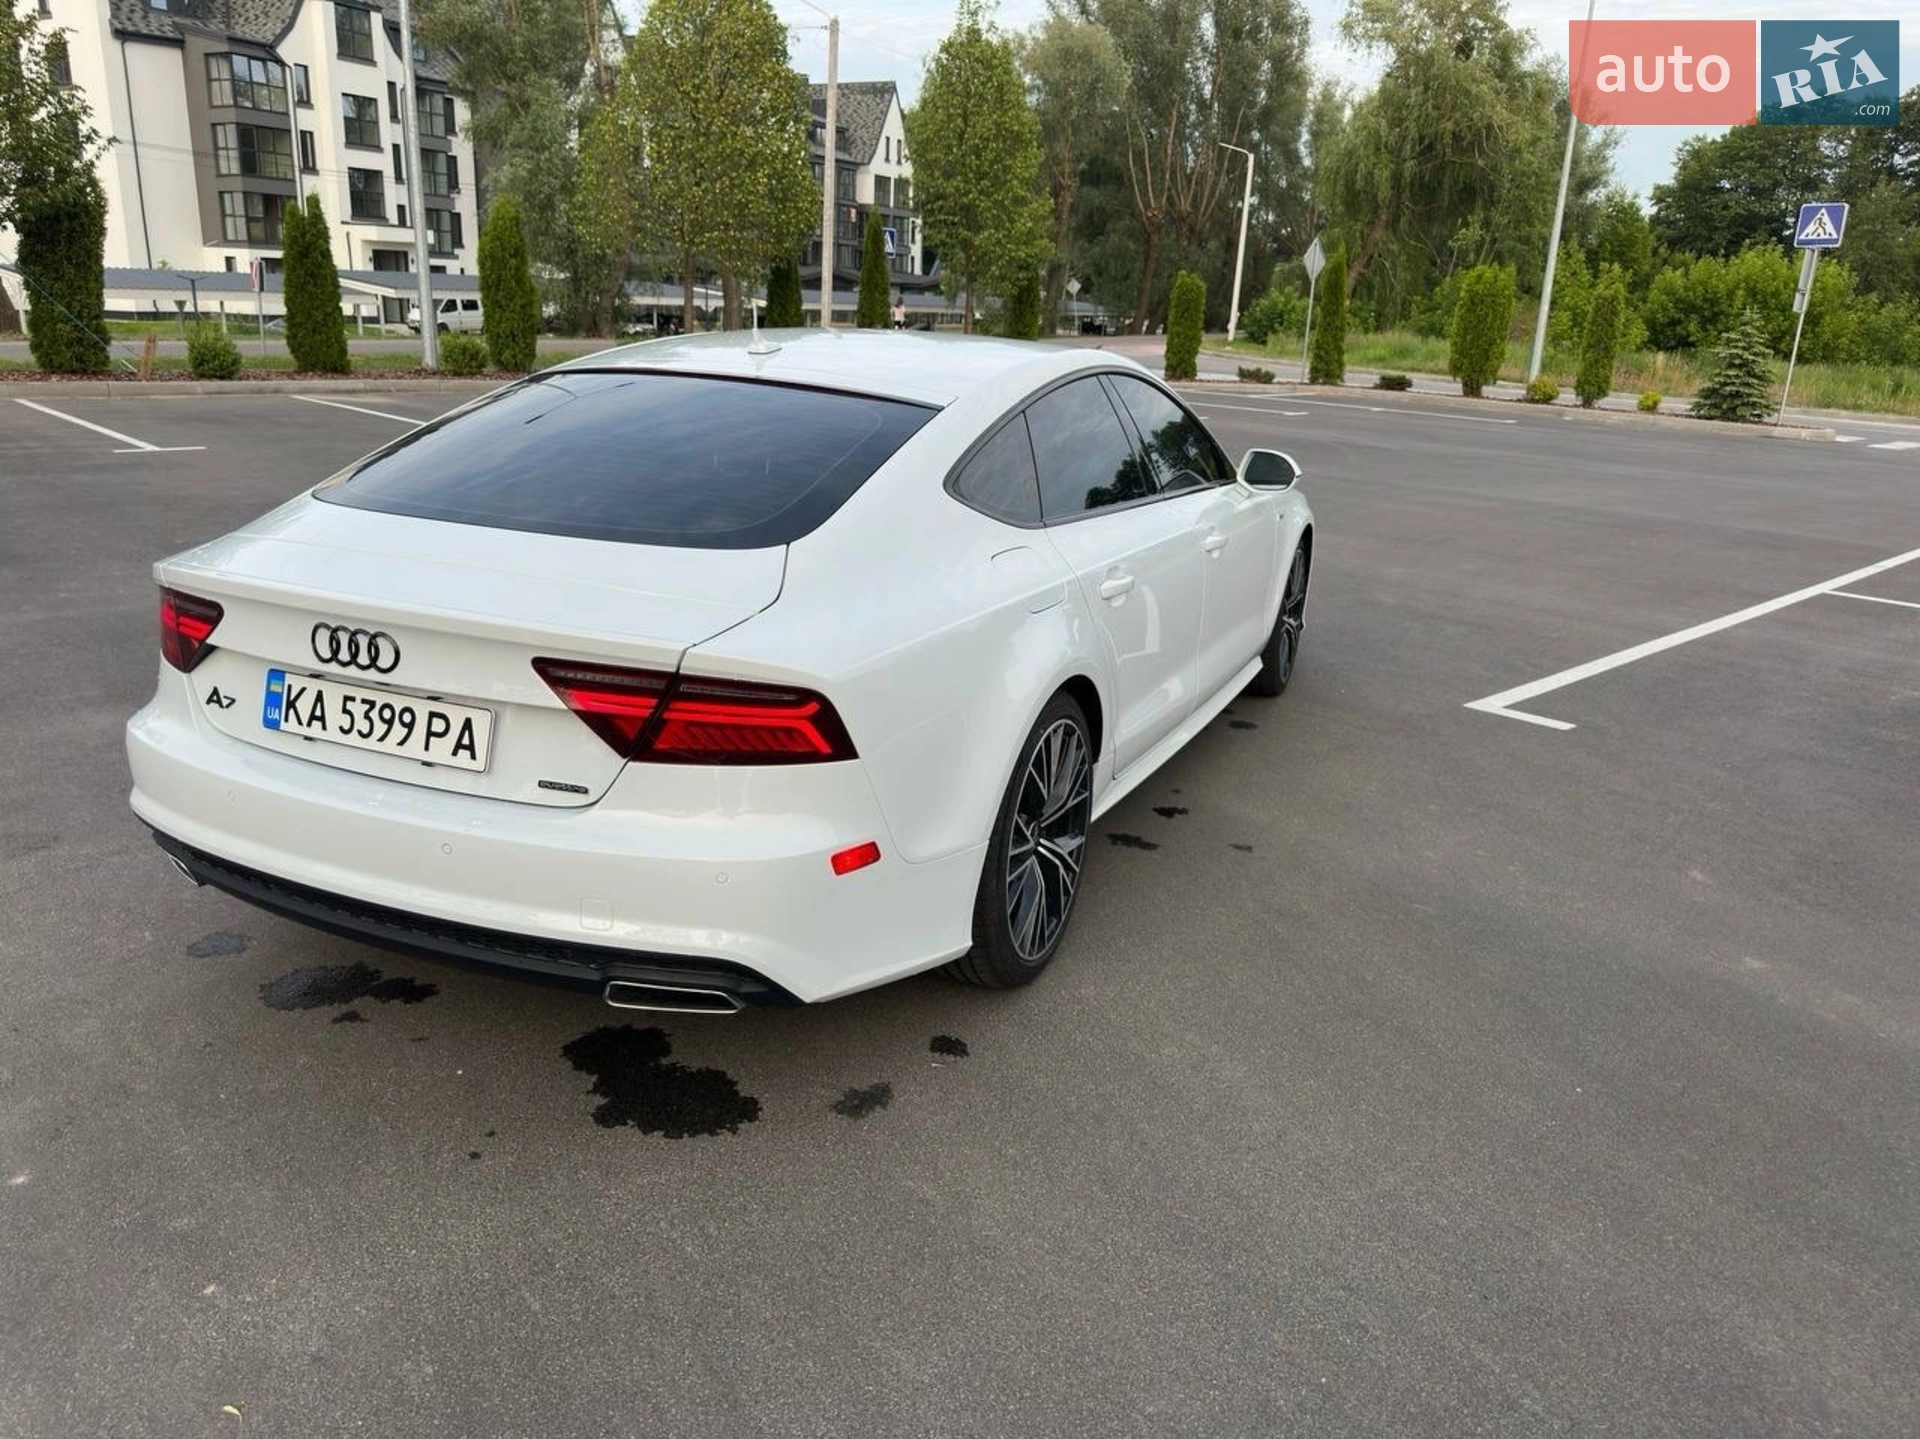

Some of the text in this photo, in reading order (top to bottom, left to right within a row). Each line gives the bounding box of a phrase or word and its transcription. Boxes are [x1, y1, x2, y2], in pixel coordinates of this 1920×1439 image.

[205, 686, 236, 709] A7
[267, 706, 280, 720] UA
[284, 683, 477, 760] KA 5399 PA
